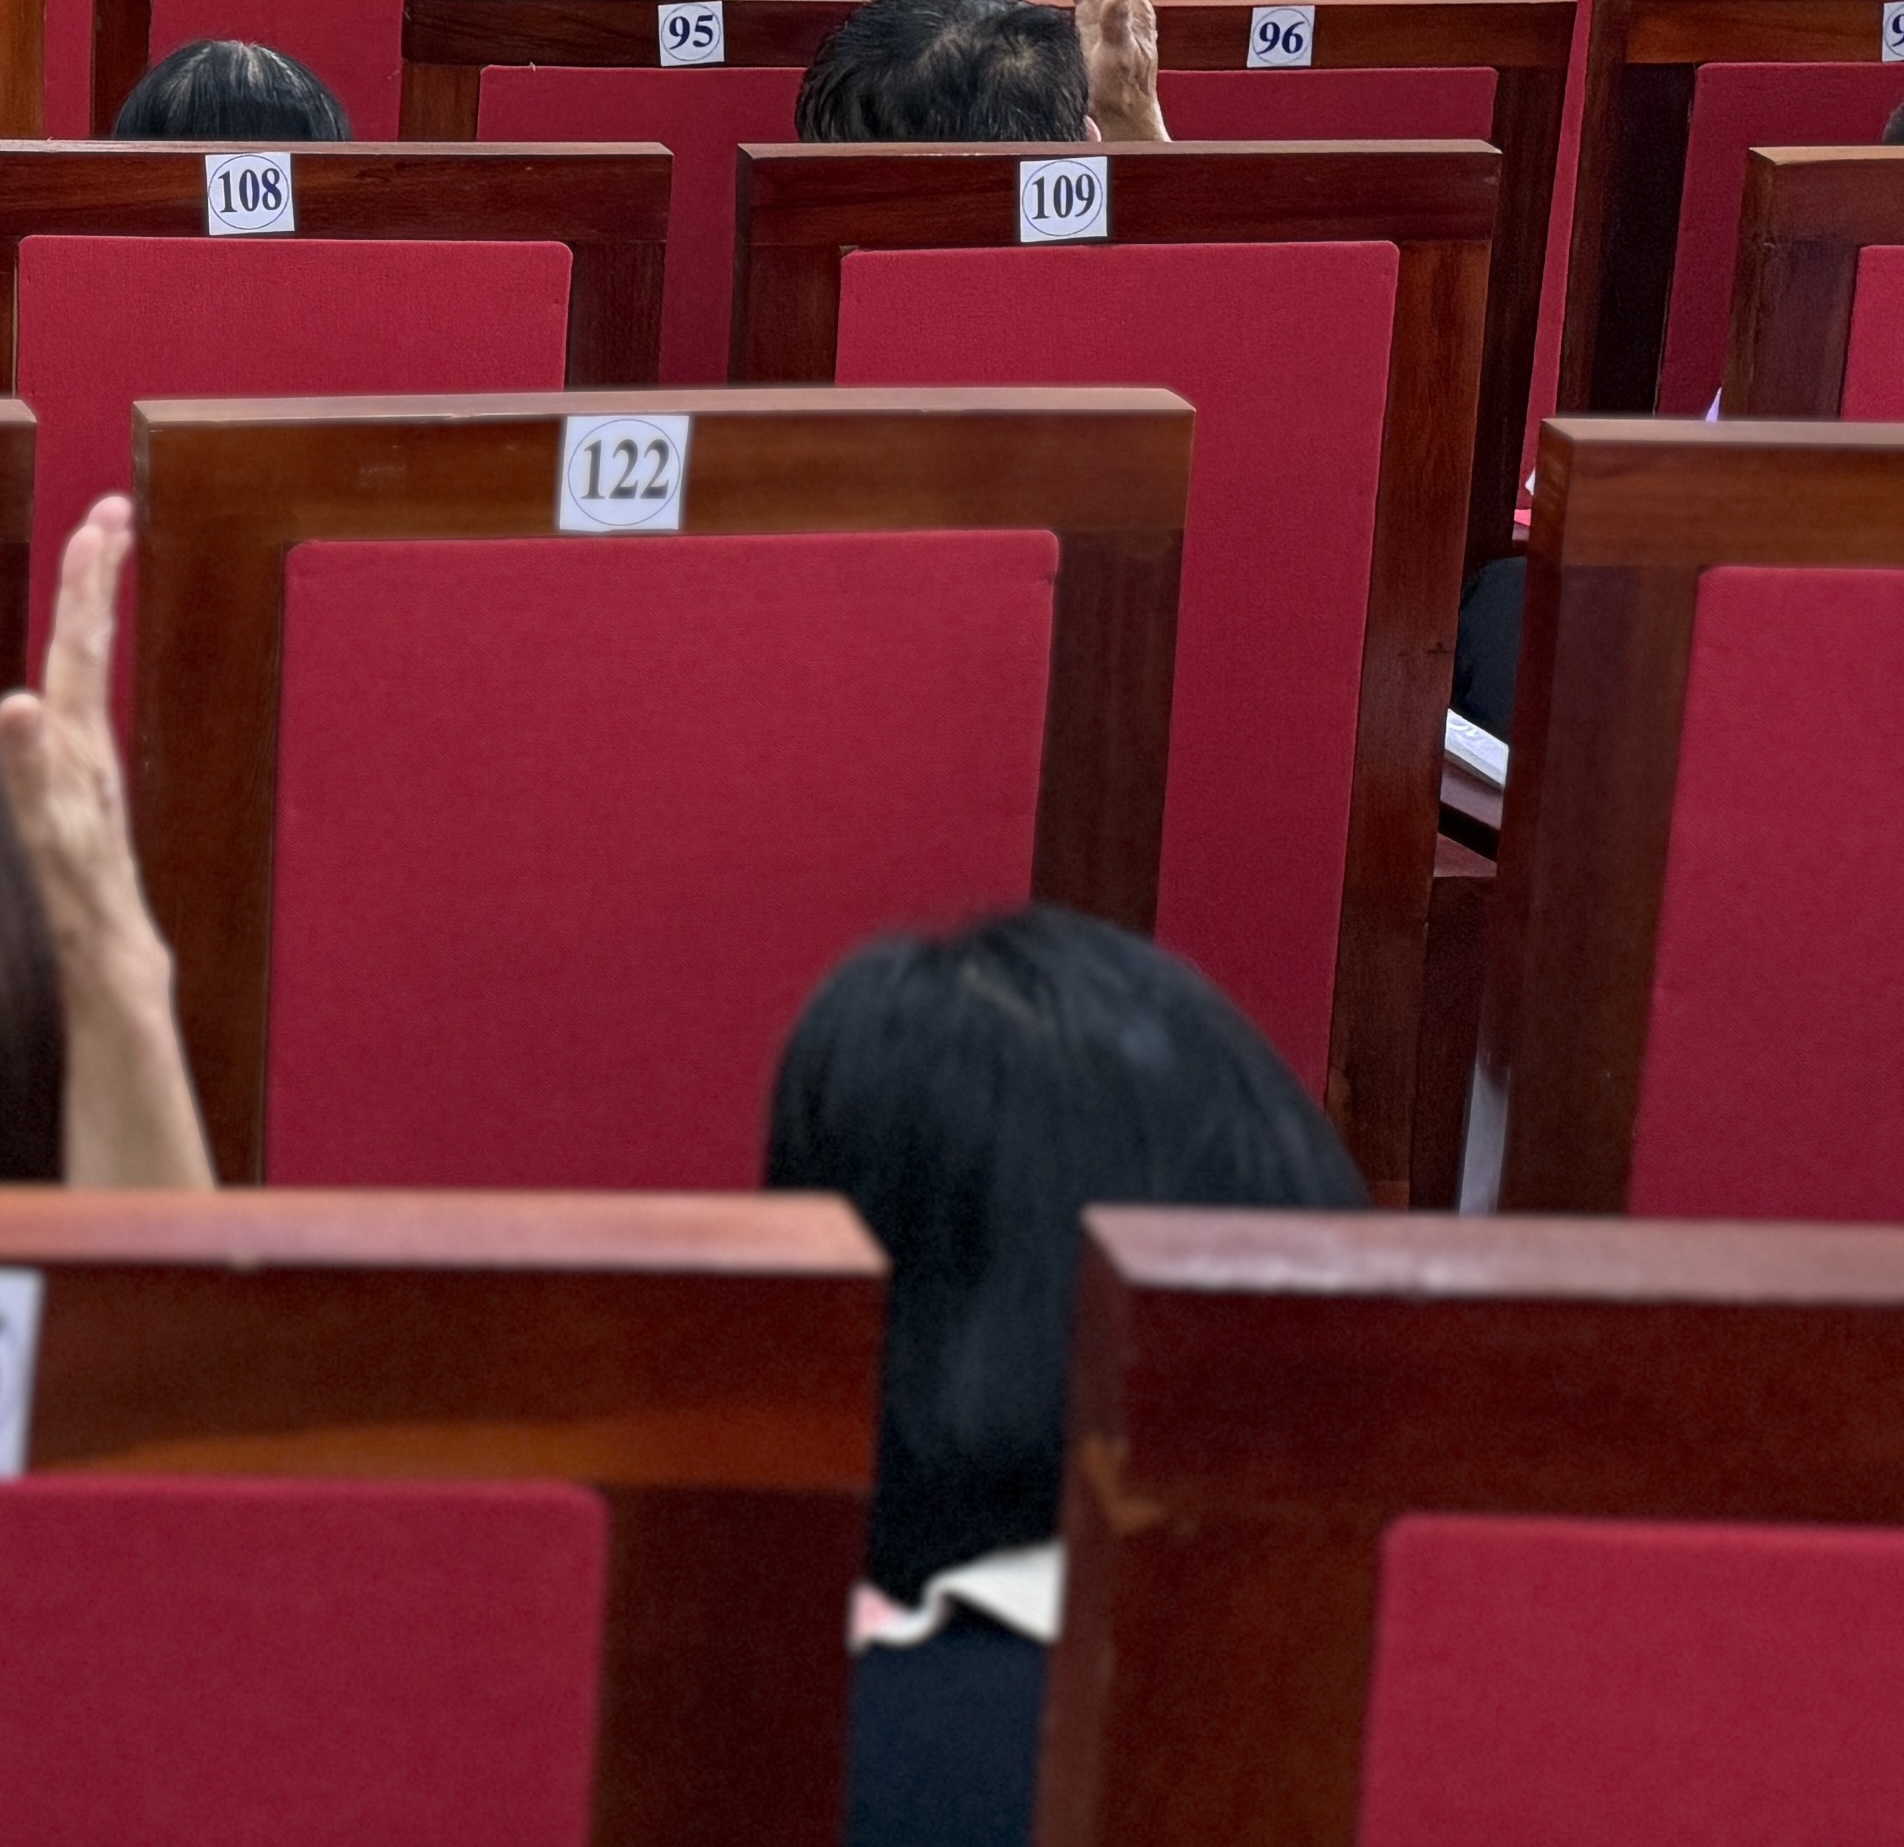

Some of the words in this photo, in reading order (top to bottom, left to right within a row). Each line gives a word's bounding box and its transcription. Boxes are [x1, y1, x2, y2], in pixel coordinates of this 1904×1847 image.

[669, 14, 714, 49] 95
[1256, 22, 1304, 55] 96
[218, 168, 281, 213] 108
[1032, 174, 1095, 219] 109
[582, 439, 669, 499] 122
